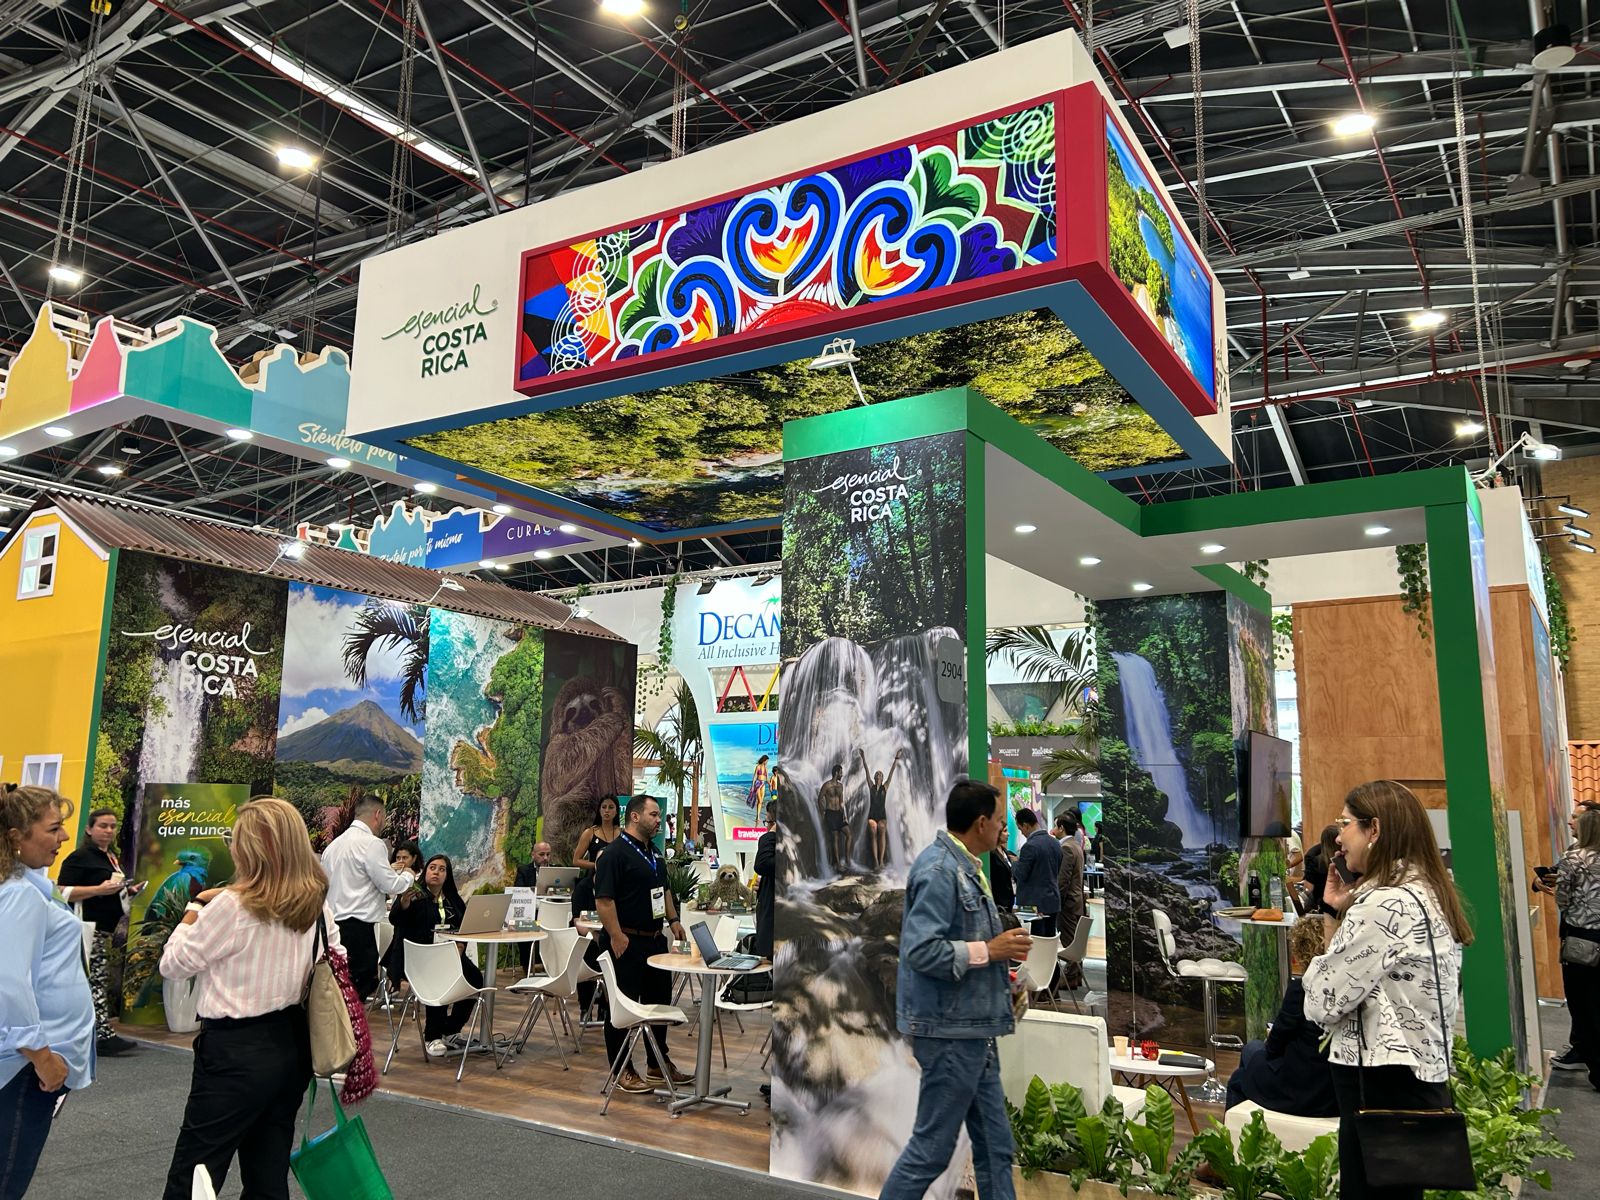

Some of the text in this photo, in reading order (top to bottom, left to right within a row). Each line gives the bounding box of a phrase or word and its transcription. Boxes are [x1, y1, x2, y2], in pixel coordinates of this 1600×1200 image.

[381, 283, 498, 340] esencial
[422, 321, 488, 355] COSTA
[421, 349, 469, 378] RICA
[811, 455, 917, 495] esencial
[850, 484, 909, 507] COSTA
[850, 504, 893, 523] RICA
[434, 532, 464, 550] mismo
[121, 621, 271, 656] esencial
[698, 645, 715, 659] All
[717, 643, 767, 658] Inclusive
[180, 650, 259, 678] COSTA
[941, 661, 962, 680] 2904
[179, 672, 238, 699] RICA
[161, 797, 191, 808] más
[158, 804, 236, 825] esencial
[158, 826, 185, 837] que
